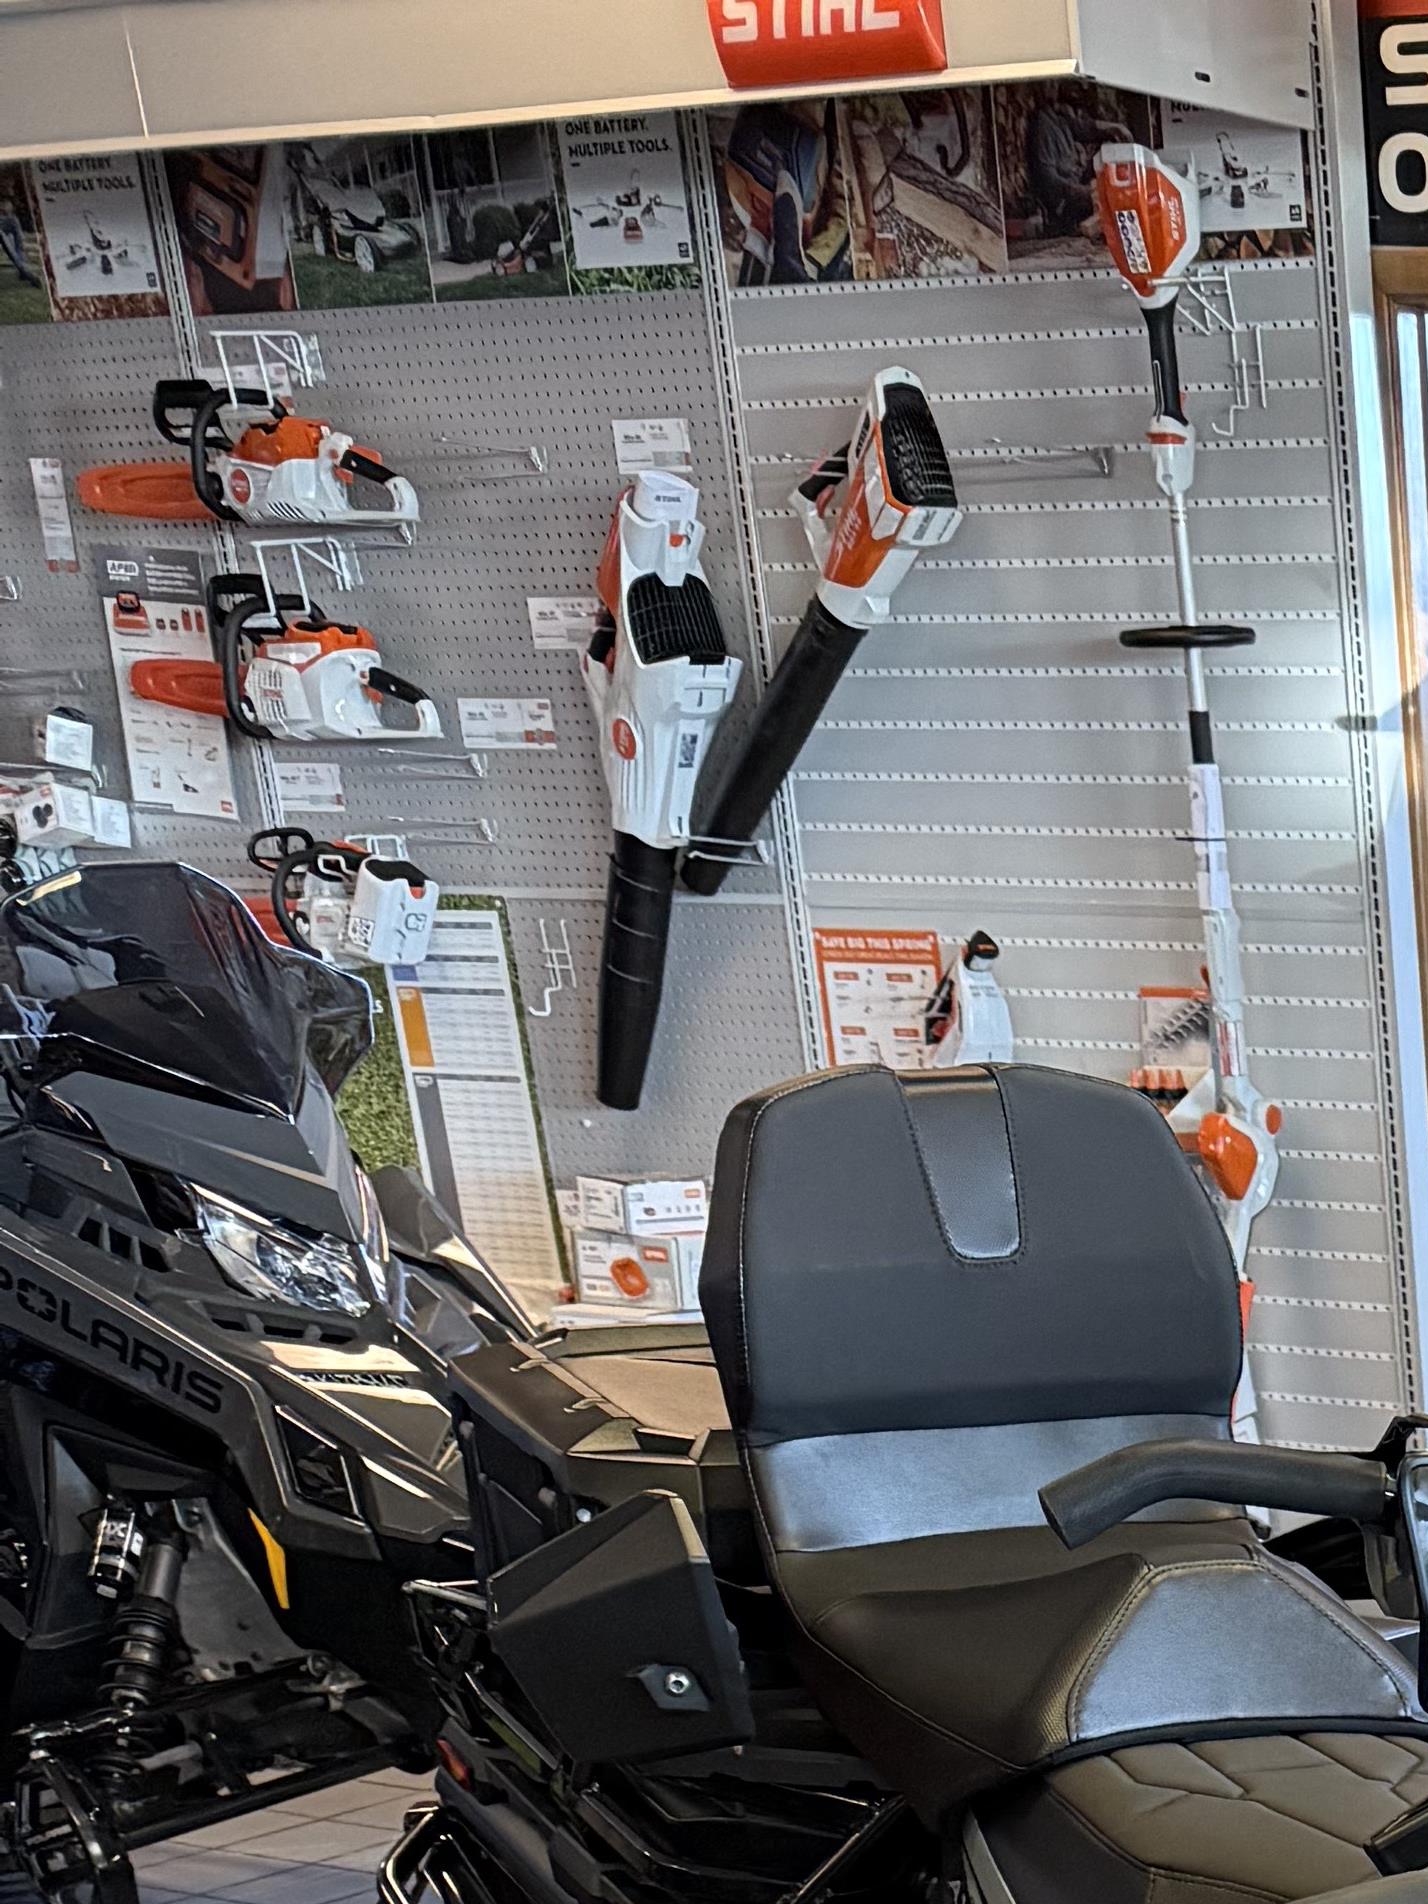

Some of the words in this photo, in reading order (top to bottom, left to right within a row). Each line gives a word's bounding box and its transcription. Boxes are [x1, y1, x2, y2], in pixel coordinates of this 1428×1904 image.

[565, 121, 591, 136] ONE
[568, 140, 626, 158] MULTIPLE
[0, 1265, 224, 1416] OLARIS
